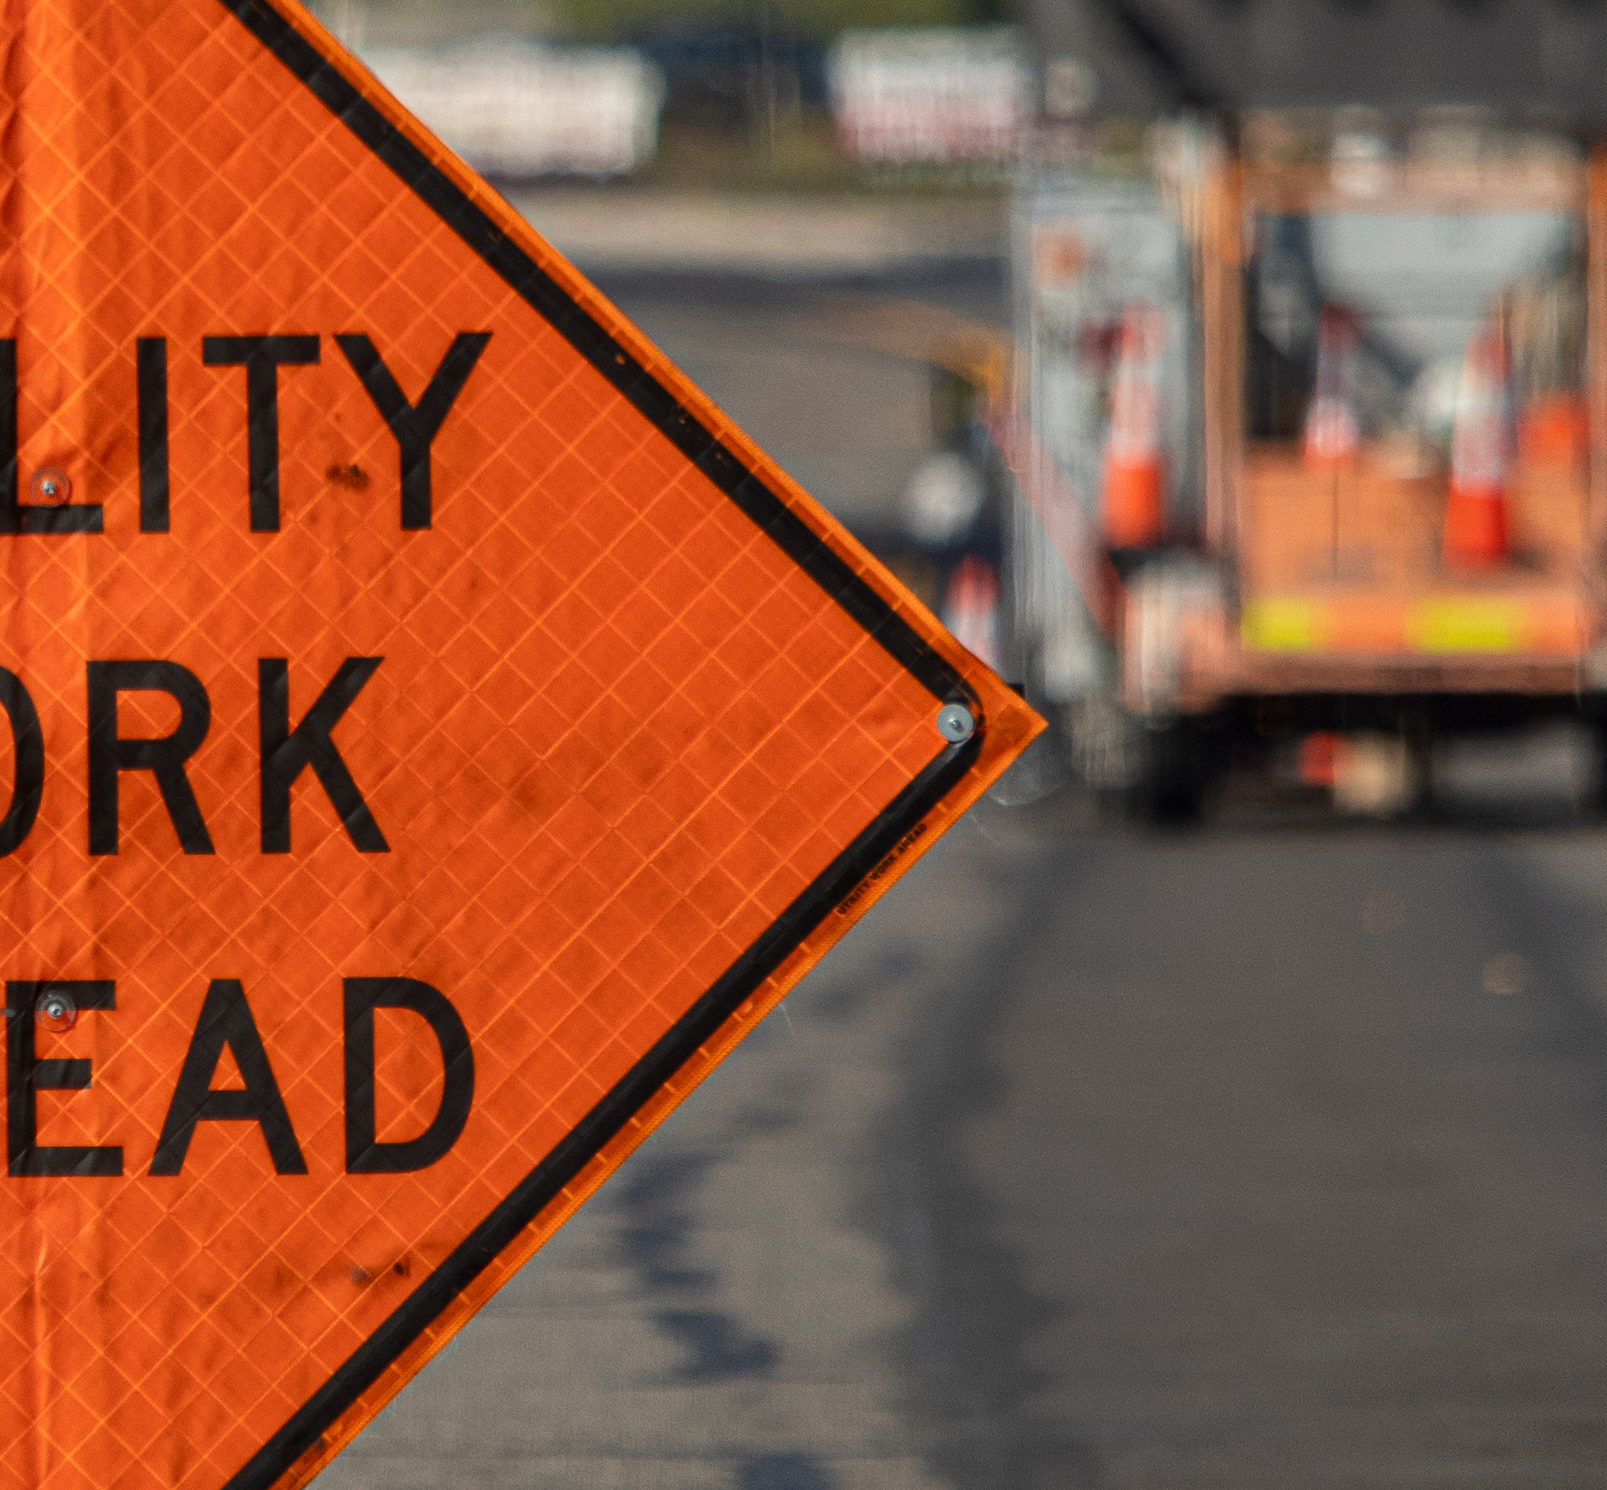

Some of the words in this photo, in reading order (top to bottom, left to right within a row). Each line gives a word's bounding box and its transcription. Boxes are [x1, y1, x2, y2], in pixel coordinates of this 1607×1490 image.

[837, 881, 871, 915] UTILITY
[870, 854, 898, 881] WORK
[898, 823, 927, 853] AHEAD
